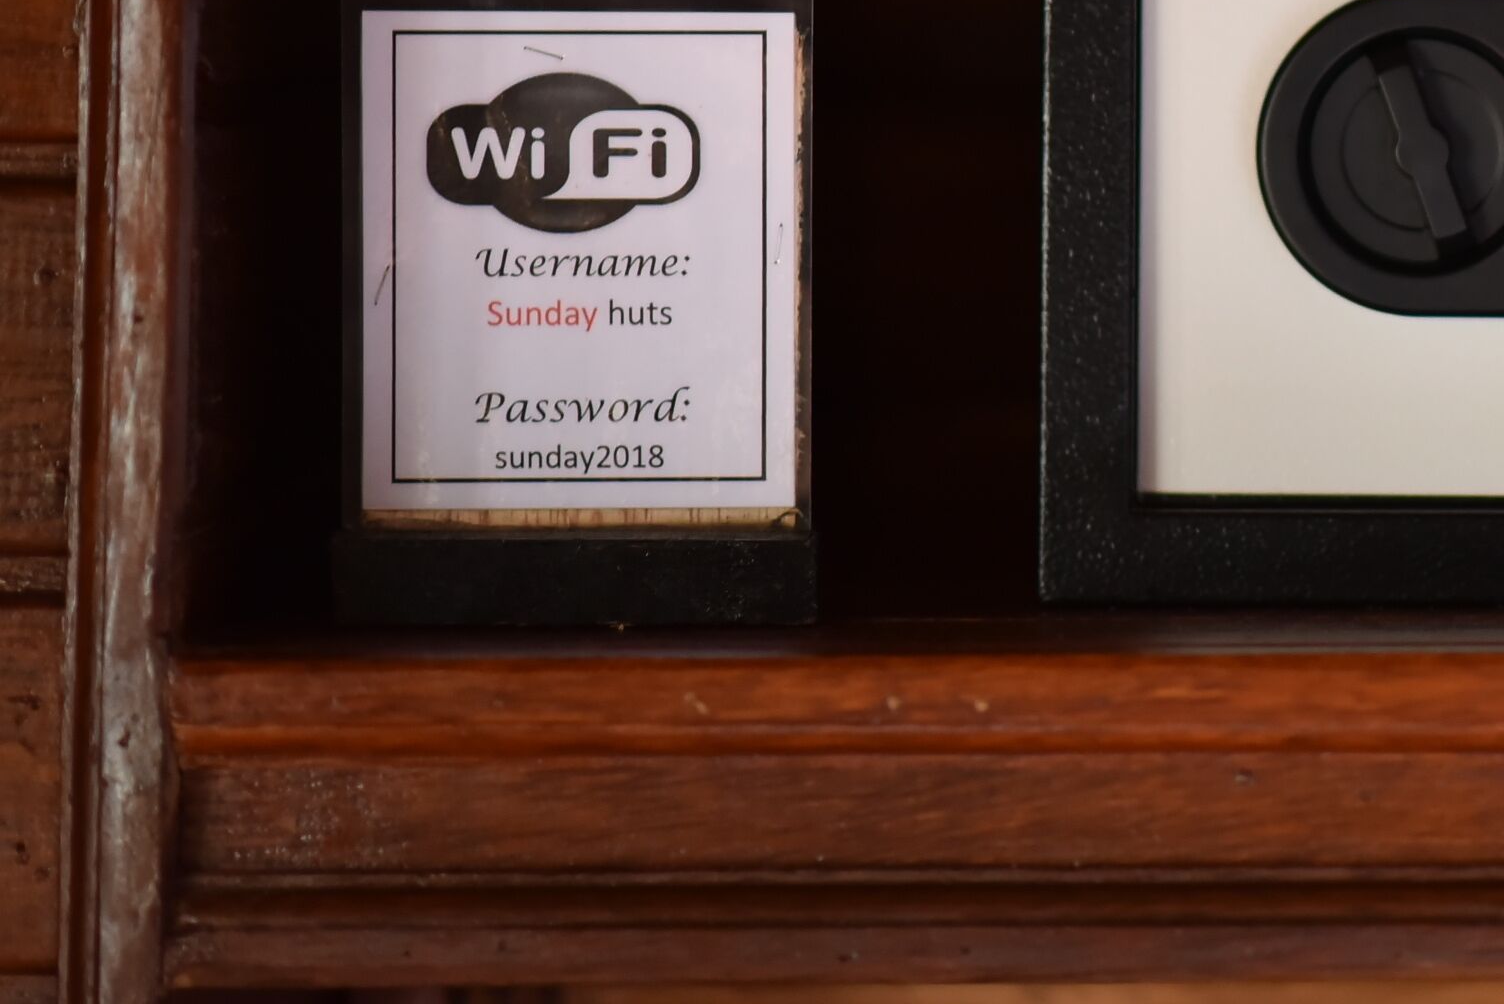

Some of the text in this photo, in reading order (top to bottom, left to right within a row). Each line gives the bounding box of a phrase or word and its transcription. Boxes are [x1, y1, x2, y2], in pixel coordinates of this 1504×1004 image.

[475, 247, 691, 278] Username:
[488, 299, 673, 331] Sunday huts
[475, 386, 691, 425] Password:
[495, 444, 664, 474] sunday2018
